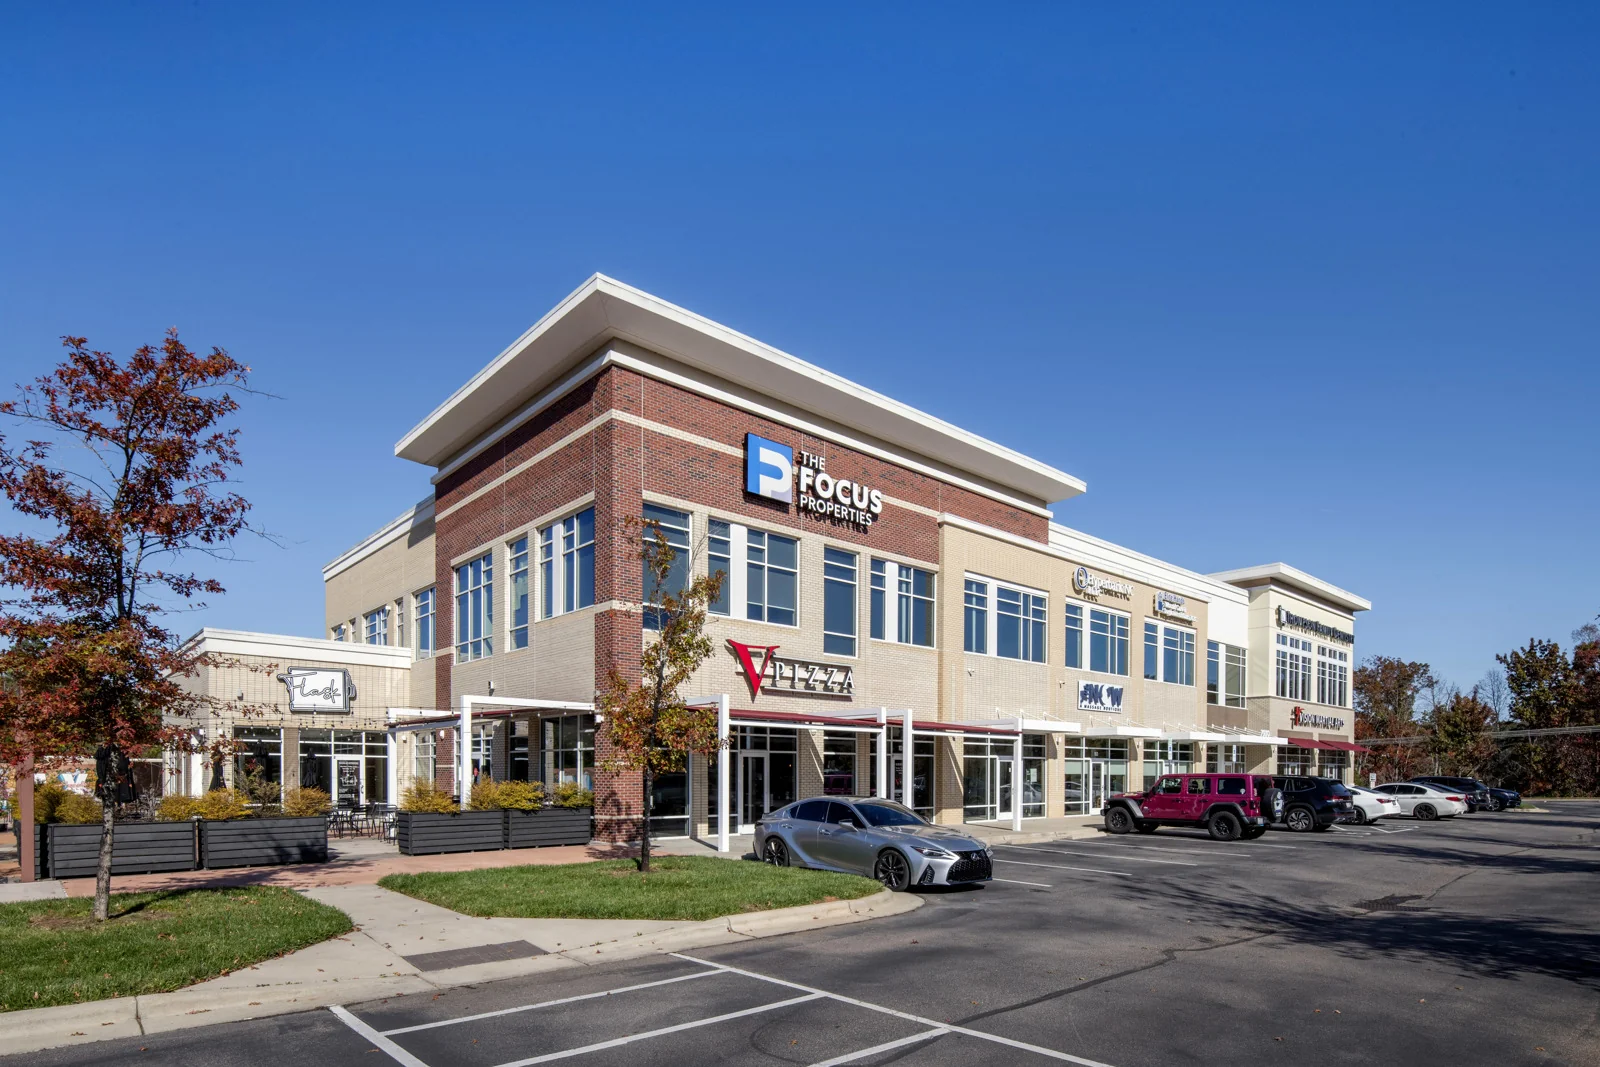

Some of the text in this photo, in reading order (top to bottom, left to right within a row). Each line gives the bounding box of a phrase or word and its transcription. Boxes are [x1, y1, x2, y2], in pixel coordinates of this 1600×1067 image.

[801, 451, 825, 470] THE
[800, 466, 882, 514] FOCUS
[800, 494, 872, 526] PROPERTIES
[726, 639, 855, 697] V PIZZA
[277, 671, 341, 703] Flask
[1300, 713, 1315, 724] VISION
[1316, 715, 1333, 726] MARTIAL
